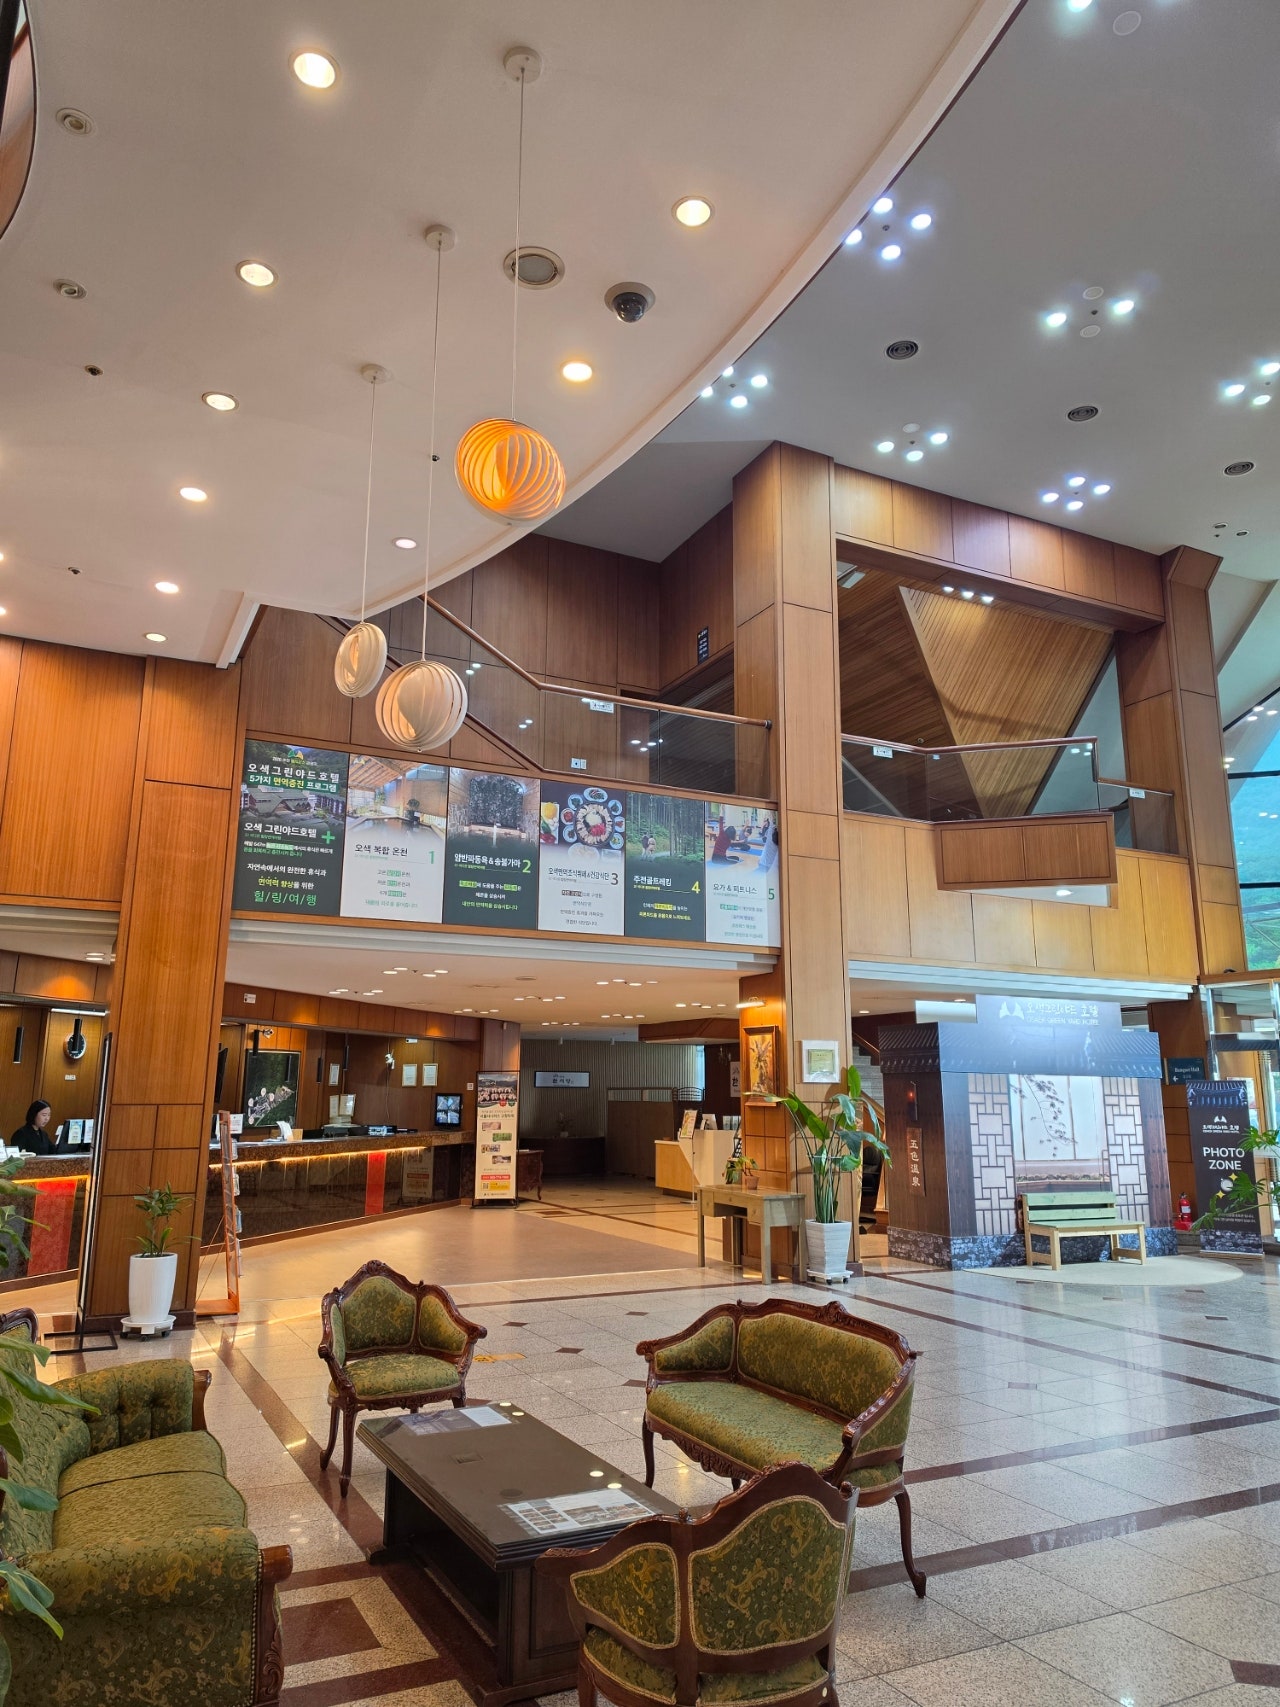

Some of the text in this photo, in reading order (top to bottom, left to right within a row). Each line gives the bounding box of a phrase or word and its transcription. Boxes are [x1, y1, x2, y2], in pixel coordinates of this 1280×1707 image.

[249, 775, 337, 793] 5가지 면역증진 프로그램
[244, 822, 262, 832] 오색
[264, 824, 317, 838] 그린야드호텔
[355, 844, 408, 856] 오색 복합 온천
[429, 851, 435, 864] 1
[247, 863, 327, 876] 자연속에서의 완전한 휴식과
[522, 859, 532, 873] 2
[611, 873, 618, 885] 3
[301, 882, 314, 890] 위한
[691, 881, 701, 894] 4
[733, 886, 757, 894] 피트니스
[254, 891, 317, 906] 힐/링/여/행
[768, 888, 775, 900] 5
[1203, 1147, 1245, 1158] PHOTO
[1208, 1160, 1242, 1170] ZONE
